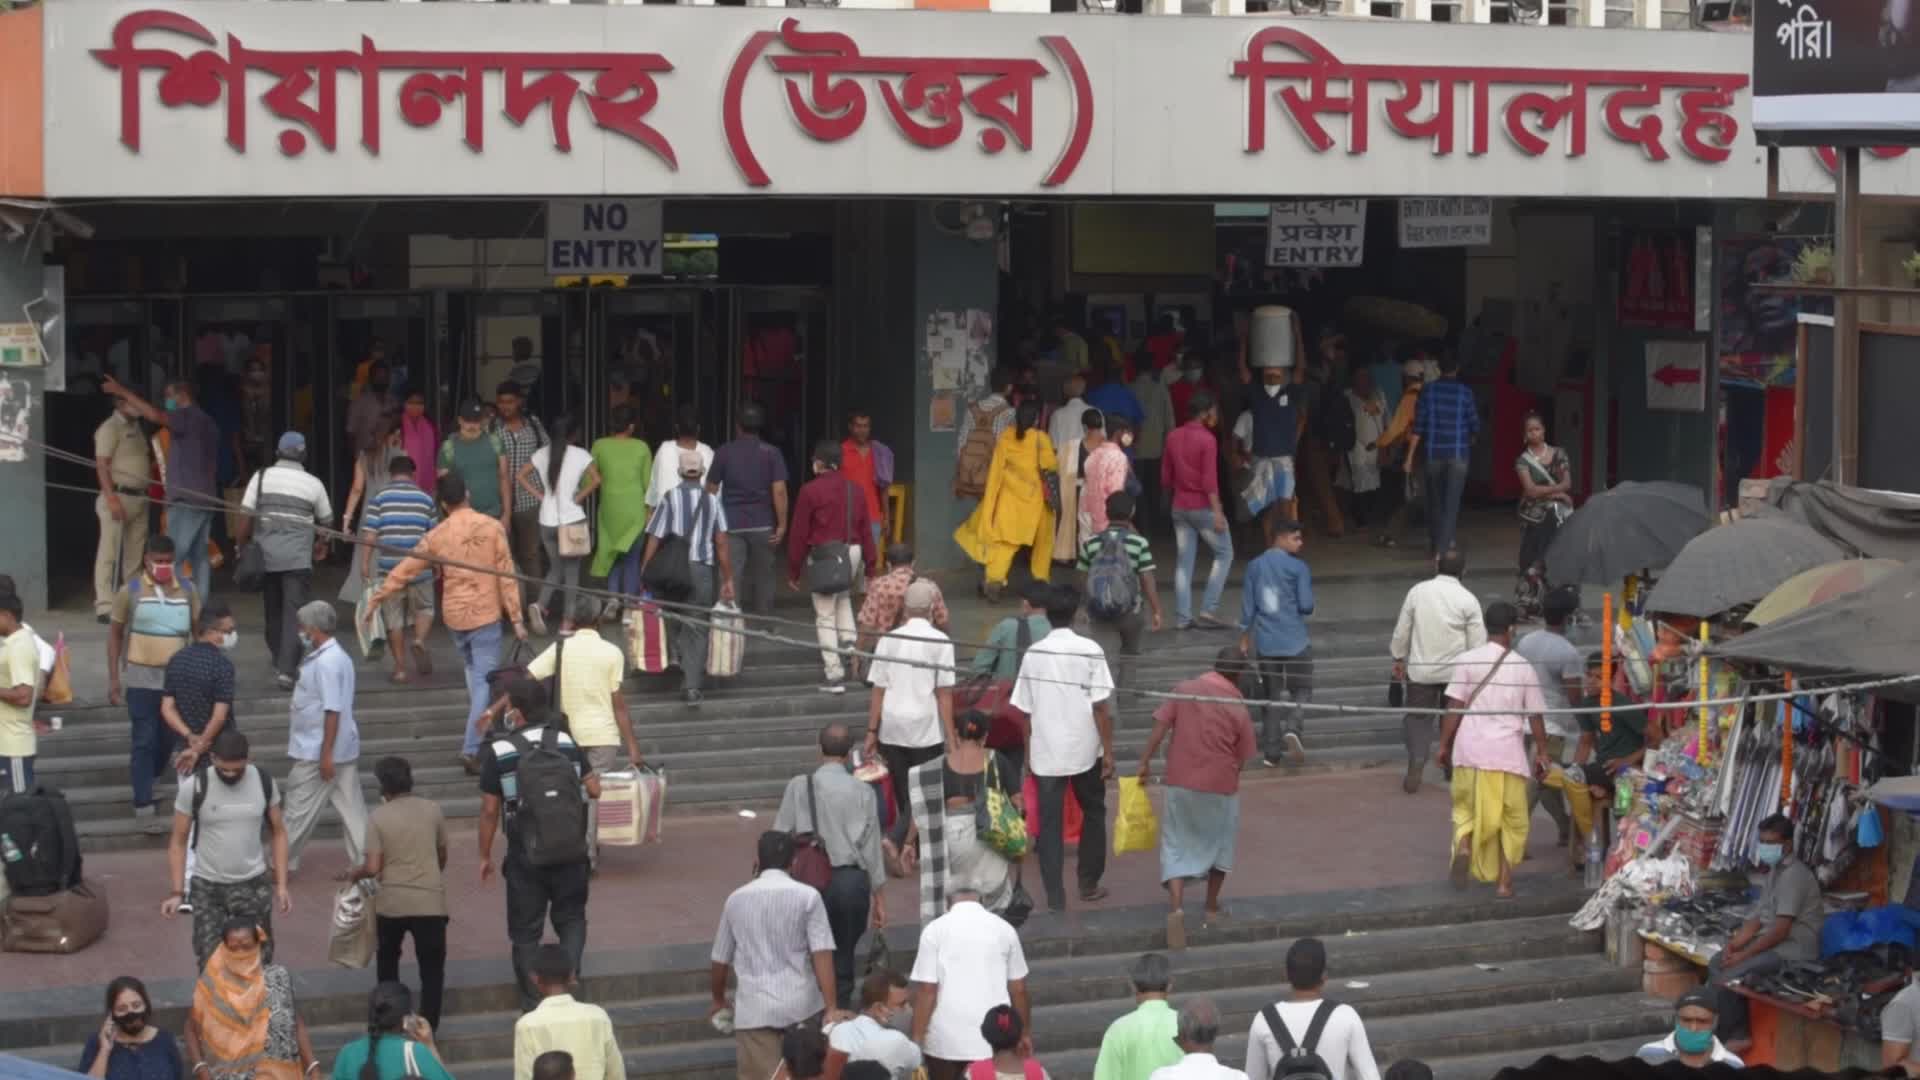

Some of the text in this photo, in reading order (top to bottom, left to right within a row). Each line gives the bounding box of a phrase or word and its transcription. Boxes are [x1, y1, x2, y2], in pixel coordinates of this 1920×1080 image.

[88, 9, 1095, 187] শিয়ালদহ (উত্তর)
[1232, 26, 1750, 163] सियालदह
[583, 203, 628, 231] NO
[1277, 217, 1358, 243] प्रवेश
[552, 240, 659, 269] ENTRY
[1272, 246, 1359, 263] ENTRY
